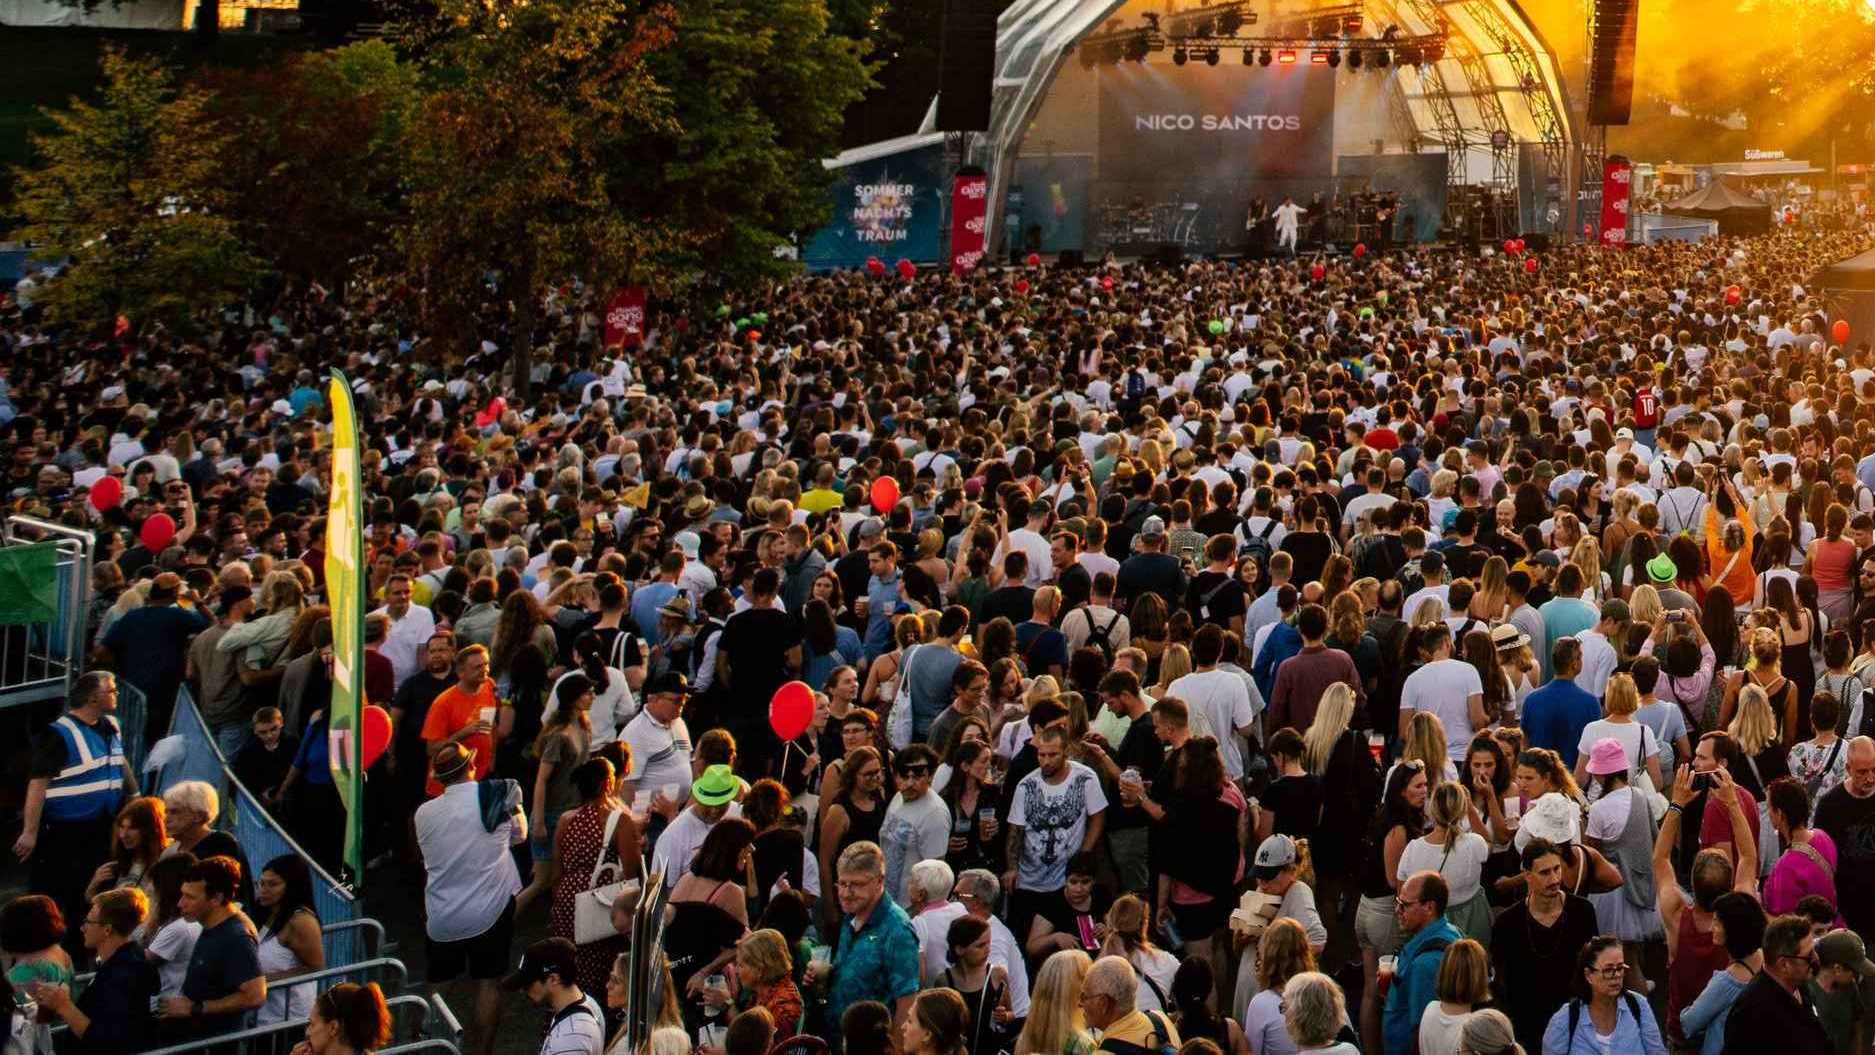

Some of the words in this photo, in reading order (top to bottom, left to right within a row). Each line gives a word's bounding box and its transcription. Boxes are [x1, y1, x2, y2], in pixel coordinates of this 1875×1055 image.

[1135, 114, 1194, 130] NICO
[1201, 114, 1300, 130] SANTOS
[854, 184, 914, 196] SOMMER
[853, 206, 912, 219] NACHTS
[855, 229, 907, 241] TRAUM
[1641, 398, 1654, 416] 10
